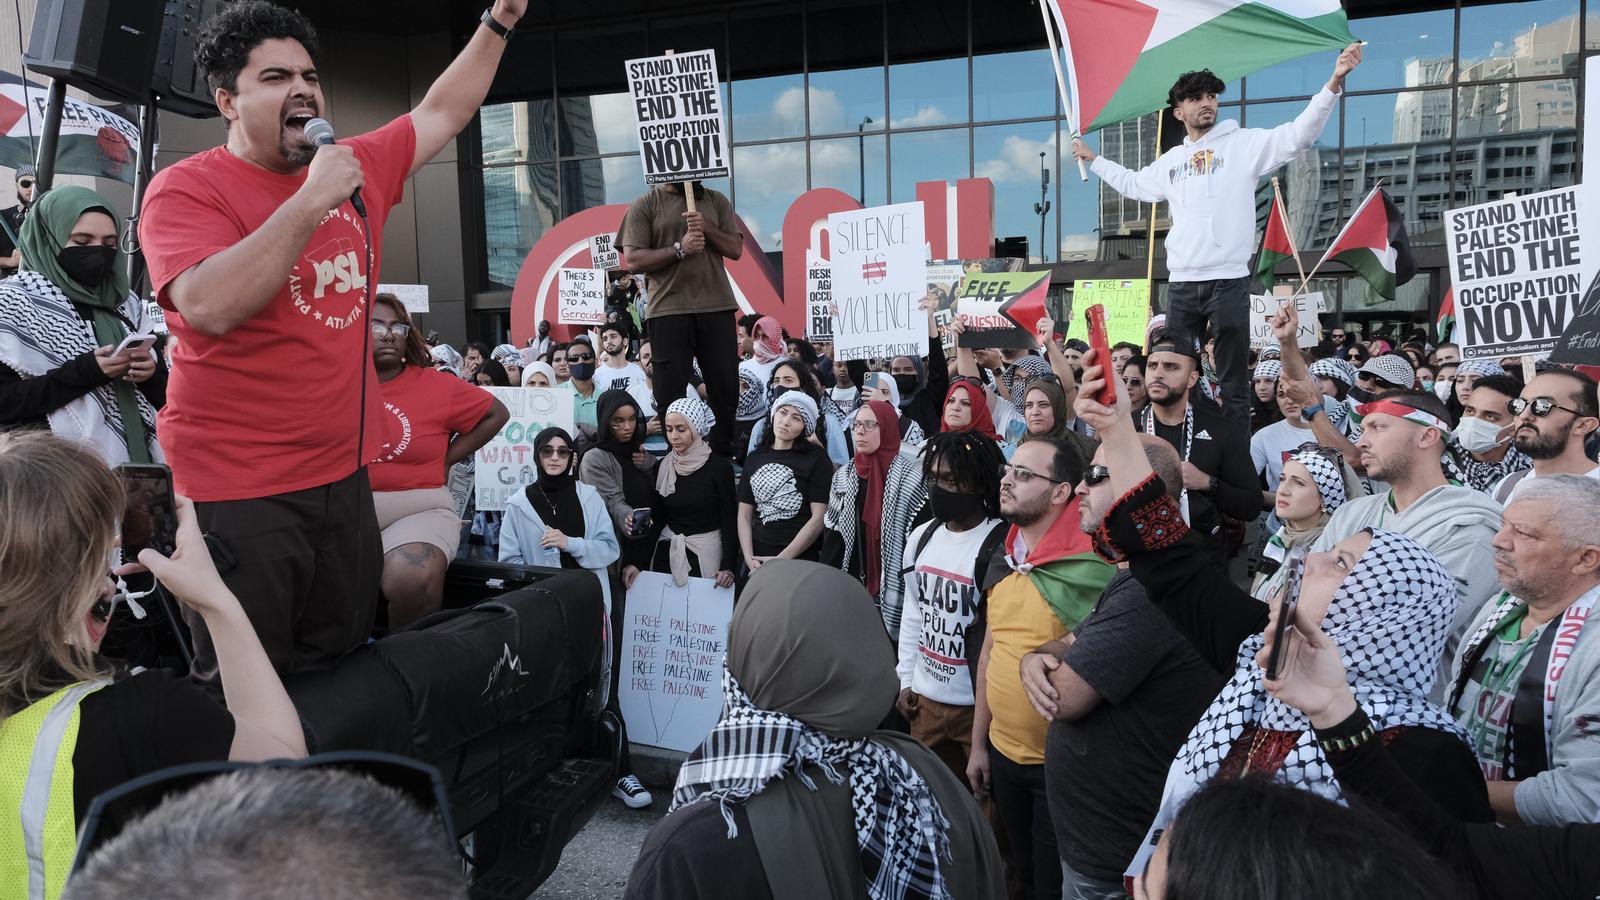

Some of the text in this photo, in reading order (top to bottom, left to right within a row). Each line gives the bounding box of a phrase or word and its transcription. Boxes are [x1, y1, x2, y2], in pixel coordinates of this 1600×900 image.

[630, 54, 711, 80] STAND WITH
[633, 72, 714, 98] PALESTINE!
[636, 90, 718, 122] END THE
[34, 97, 139, 141] FEE PALES
[640, 118, 720, 141] OCCUPATION
[643, 134, 723, 174] NOW!
[1453, 191, 1576, 232] STAND WITH
[595, 235, 610, 245] END
[837, 212, 912, 254] SILENCE
[1455, 212, 1578, 253] PALESTINE!
[593, 252, 617, 264] U.S. AID
[598, 245, 610, 254] ALL
[1457, 235, 1581, 282] END THE
[313, 251, 367, 299] PSL
[564, 270, 595, 281] THERE'S
[573, 282, 586, 290] NO
[1098, 281, 1116, 289] FREE
[289, 274, 311, 314] PARTY
[964, 279, 1010, 302] FREE
[1074, 289, 1144, 308] PALESTINE
[1459, 273, 1581, 307] OCCUPATION
[812, 305, 828, 316] IS A
[834, 291, 917, 335] VIOLENCE
[840, 342, 920, 361] FREE FREE PALESTINE
[1506, 344, 1539, 352] Socialism
[1567, 331, 1600, 350] #End
[611, 377, 630, 389] NIKE
[393, 412, 411, 455] LIBERATION
[915, 571, 978, 617] BLACK
[635, 614, 717, 634] FREE PALESTINE
[634, 629, 722, 653] FREE PALESTINE
[632, 645, 717, 666] FREE PALESTINE
[632, 661, 713, 682] FREE PALESTINE
[631, 677, 710, 699] FREE PALESTINE
